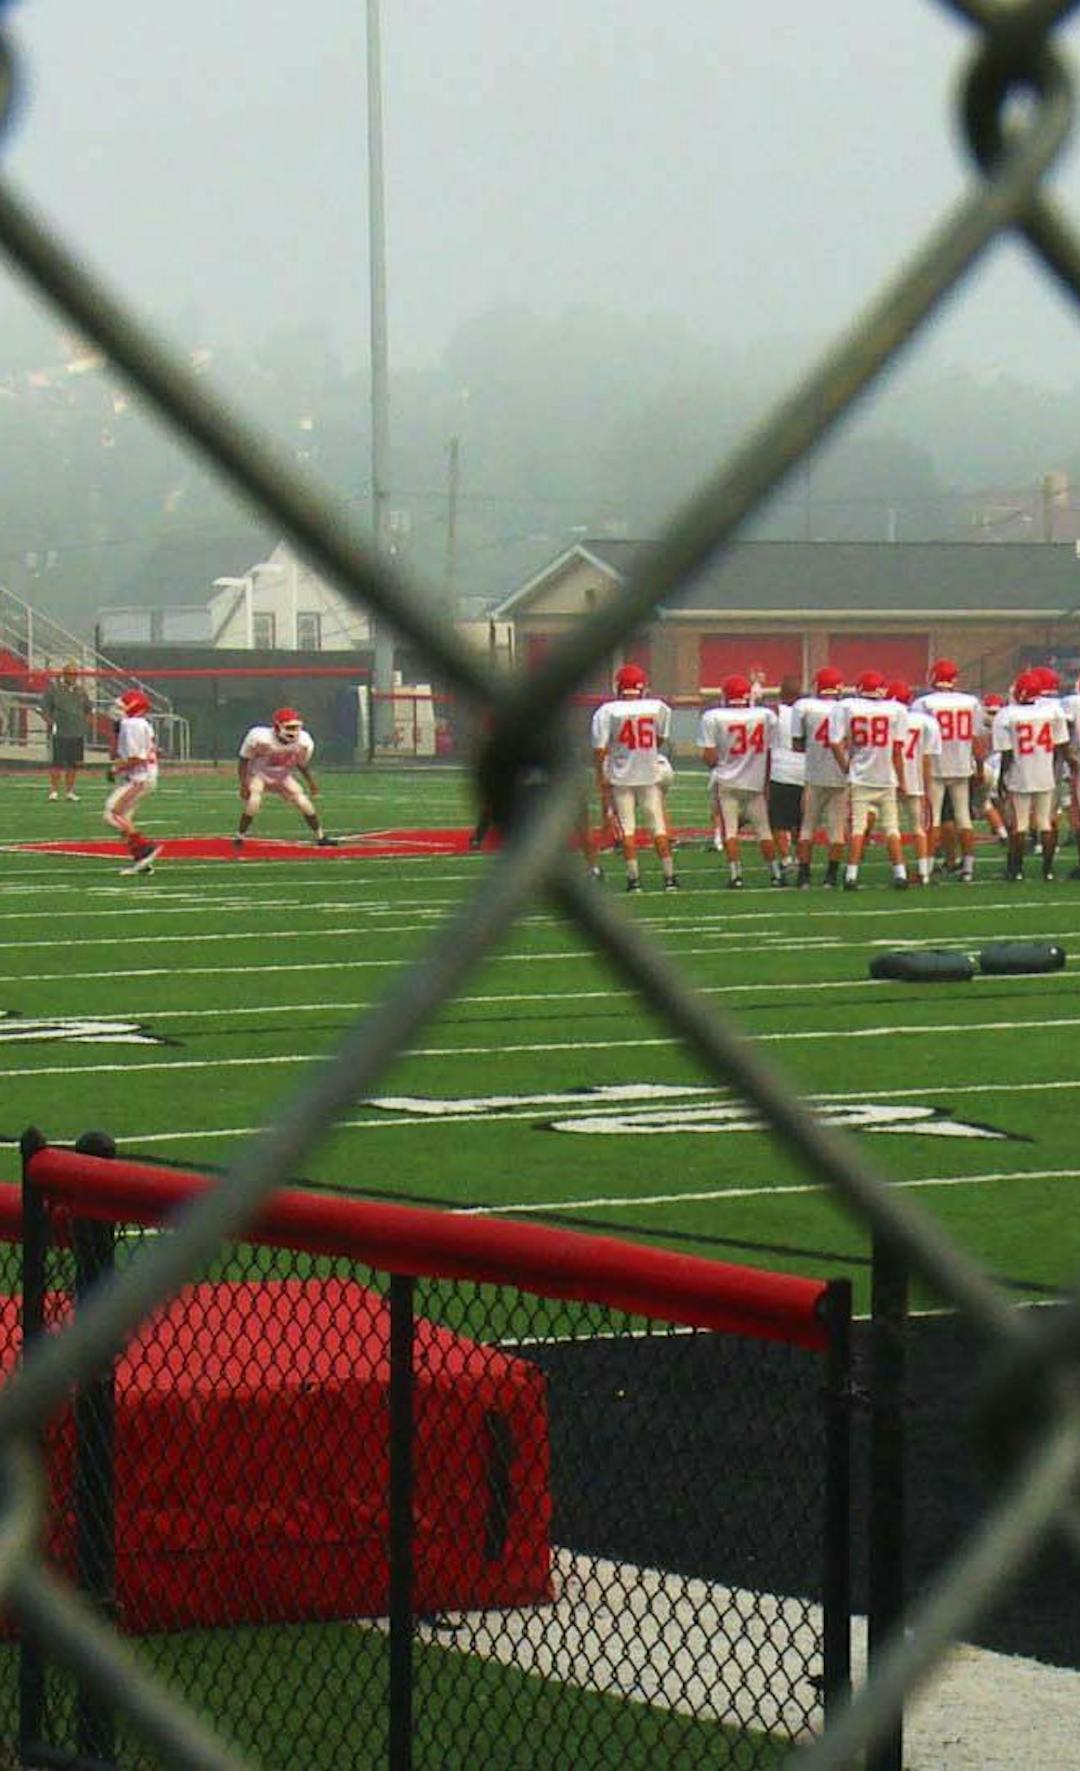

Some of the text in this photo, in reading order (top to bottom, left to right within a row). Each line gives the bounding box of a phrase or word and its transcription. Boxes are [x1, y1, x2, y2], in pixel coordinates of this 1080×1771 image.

[618, 717, 654, 750] 46
[728, 723, 765, 756] 34
[850, 716, 889, 747] 68
[936, 710, 972, 741] 90
[1015, 722, 1055, 755] 24
